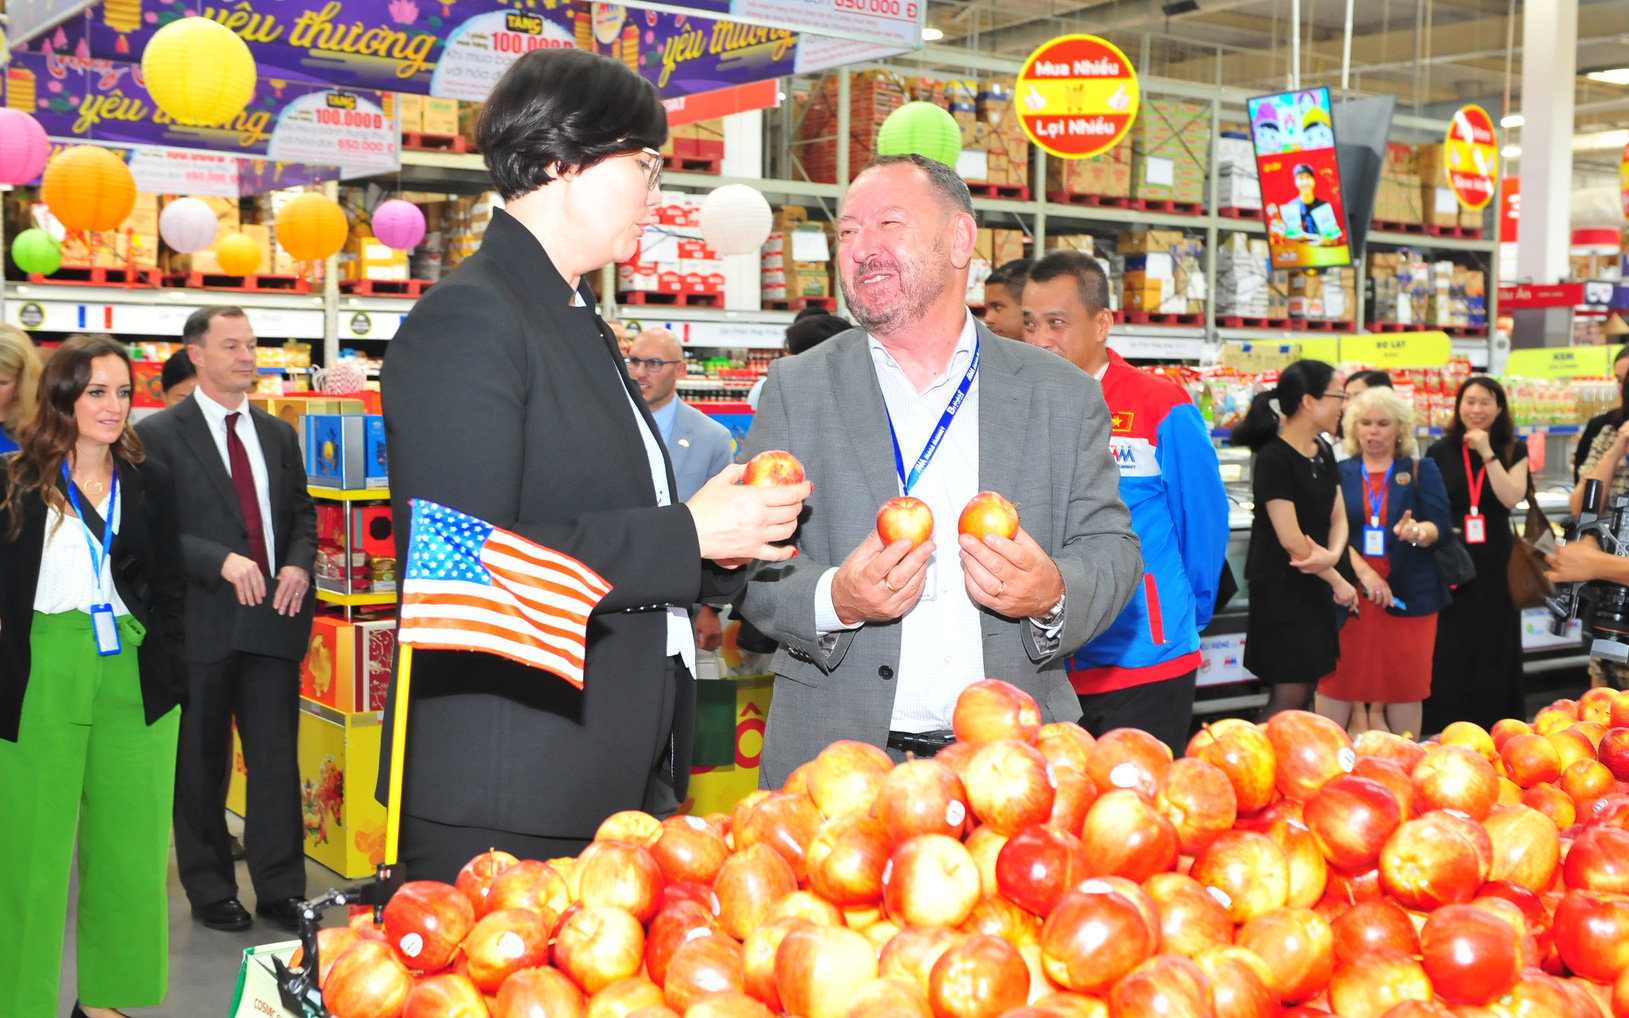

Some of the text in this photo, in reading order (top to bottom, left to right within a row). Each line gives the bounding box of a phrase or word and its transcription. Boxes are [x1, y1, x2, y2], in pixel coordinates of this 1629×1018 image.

[289, 0, 437, 78] thương
[658, 22, 709, 88] yêu
[1035, 56, 1119, 77] Mua Nhiều
[72, 88, 149, 134] yêu
[1036, 115, 1115, 139] Lợi Nhiều
